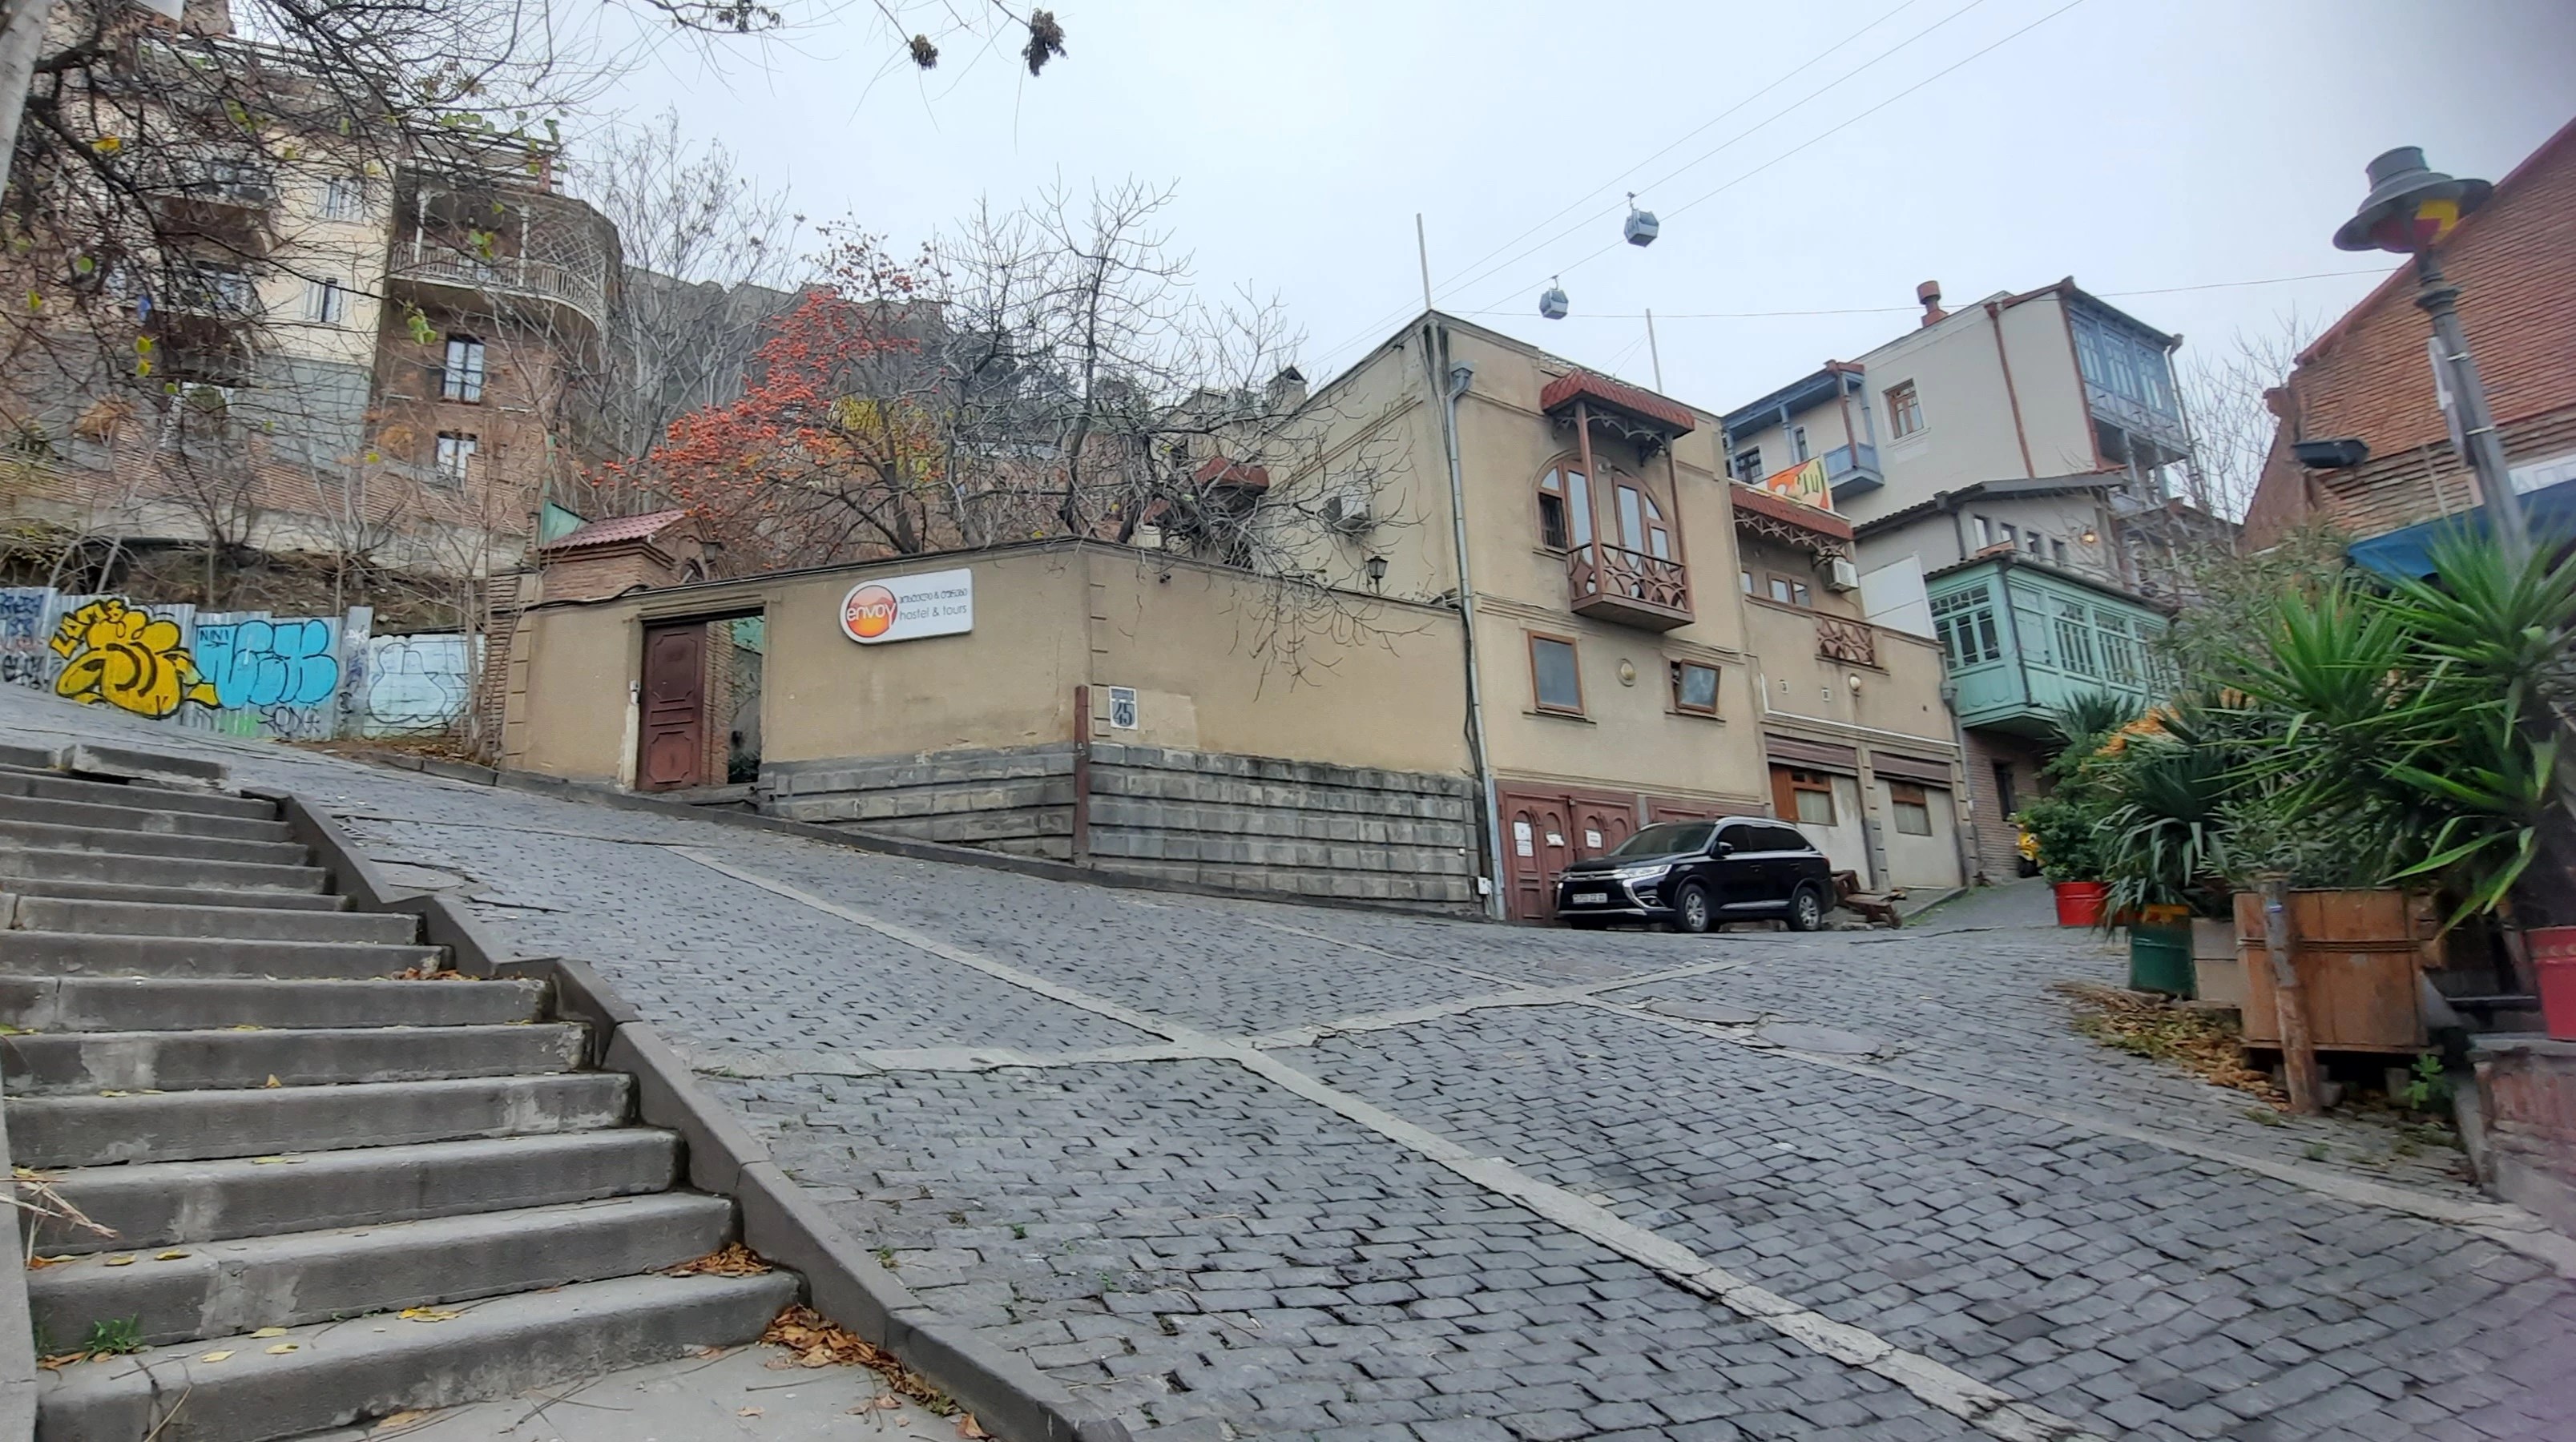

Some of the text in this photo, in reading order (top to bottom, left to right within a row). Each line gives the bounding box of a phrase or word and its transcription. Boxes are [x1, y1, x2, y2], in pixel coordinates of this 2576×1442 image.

[847, 602, 897, 630] envoy
[899, 605, 967, 621] hostel & tours
